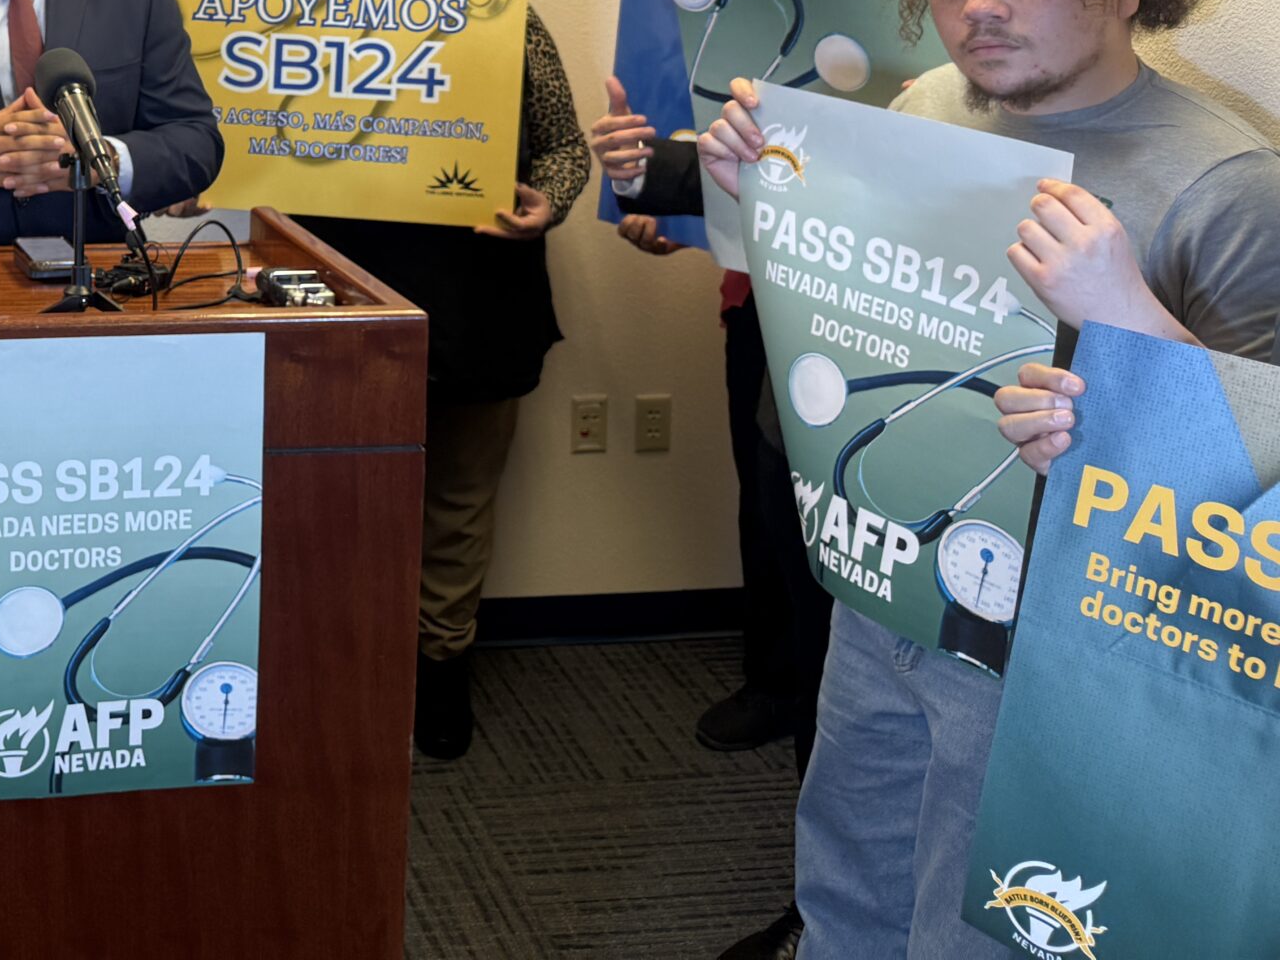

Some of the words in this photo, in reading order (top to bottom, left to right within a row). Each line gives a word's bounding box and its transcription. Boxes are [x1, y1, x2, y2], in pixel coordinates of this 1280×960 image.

[218, 30, 451, 104] SB124
[224, 107, 310, 132] ACCESO,
[313, 110, 357, 132] MÁS
[359, 116, 489, 143] COMPASIÓN,
[249, 135, 291, 156] MÁS
[294, 139, 408, 164] DOCTORES!
[753, 200, 855, 273] PASS
[863, 237, 1010, 325] SB124
[765, 259, 839, 307] NEVADA
[842, 286, 914, 332] NEEDS
[917, 311, 985, 357] MORE
[810, 313, 911, 369] DOCTORS
[55, 454, 215, 503] SB124
[41, 512, 120, 536] NEEDS
[125, 508, 193, 532] MORE
[820, 494, 920, 577] AFP
[9, 546, 122, 572] DOCTORS
[818, 542, 893, 602] NEVADA
[1085, 551, 1182, 614] Bring
[1187, 594, 1280, 646] more
[1079, 590, 1219, 662] doctors
[1228, 642, 1267, 681] to
[55, 698, 166, 754] AFP
[54, 748, 146, 775] NEVADA
[1004, 893, 1029, 905] BATTLE
